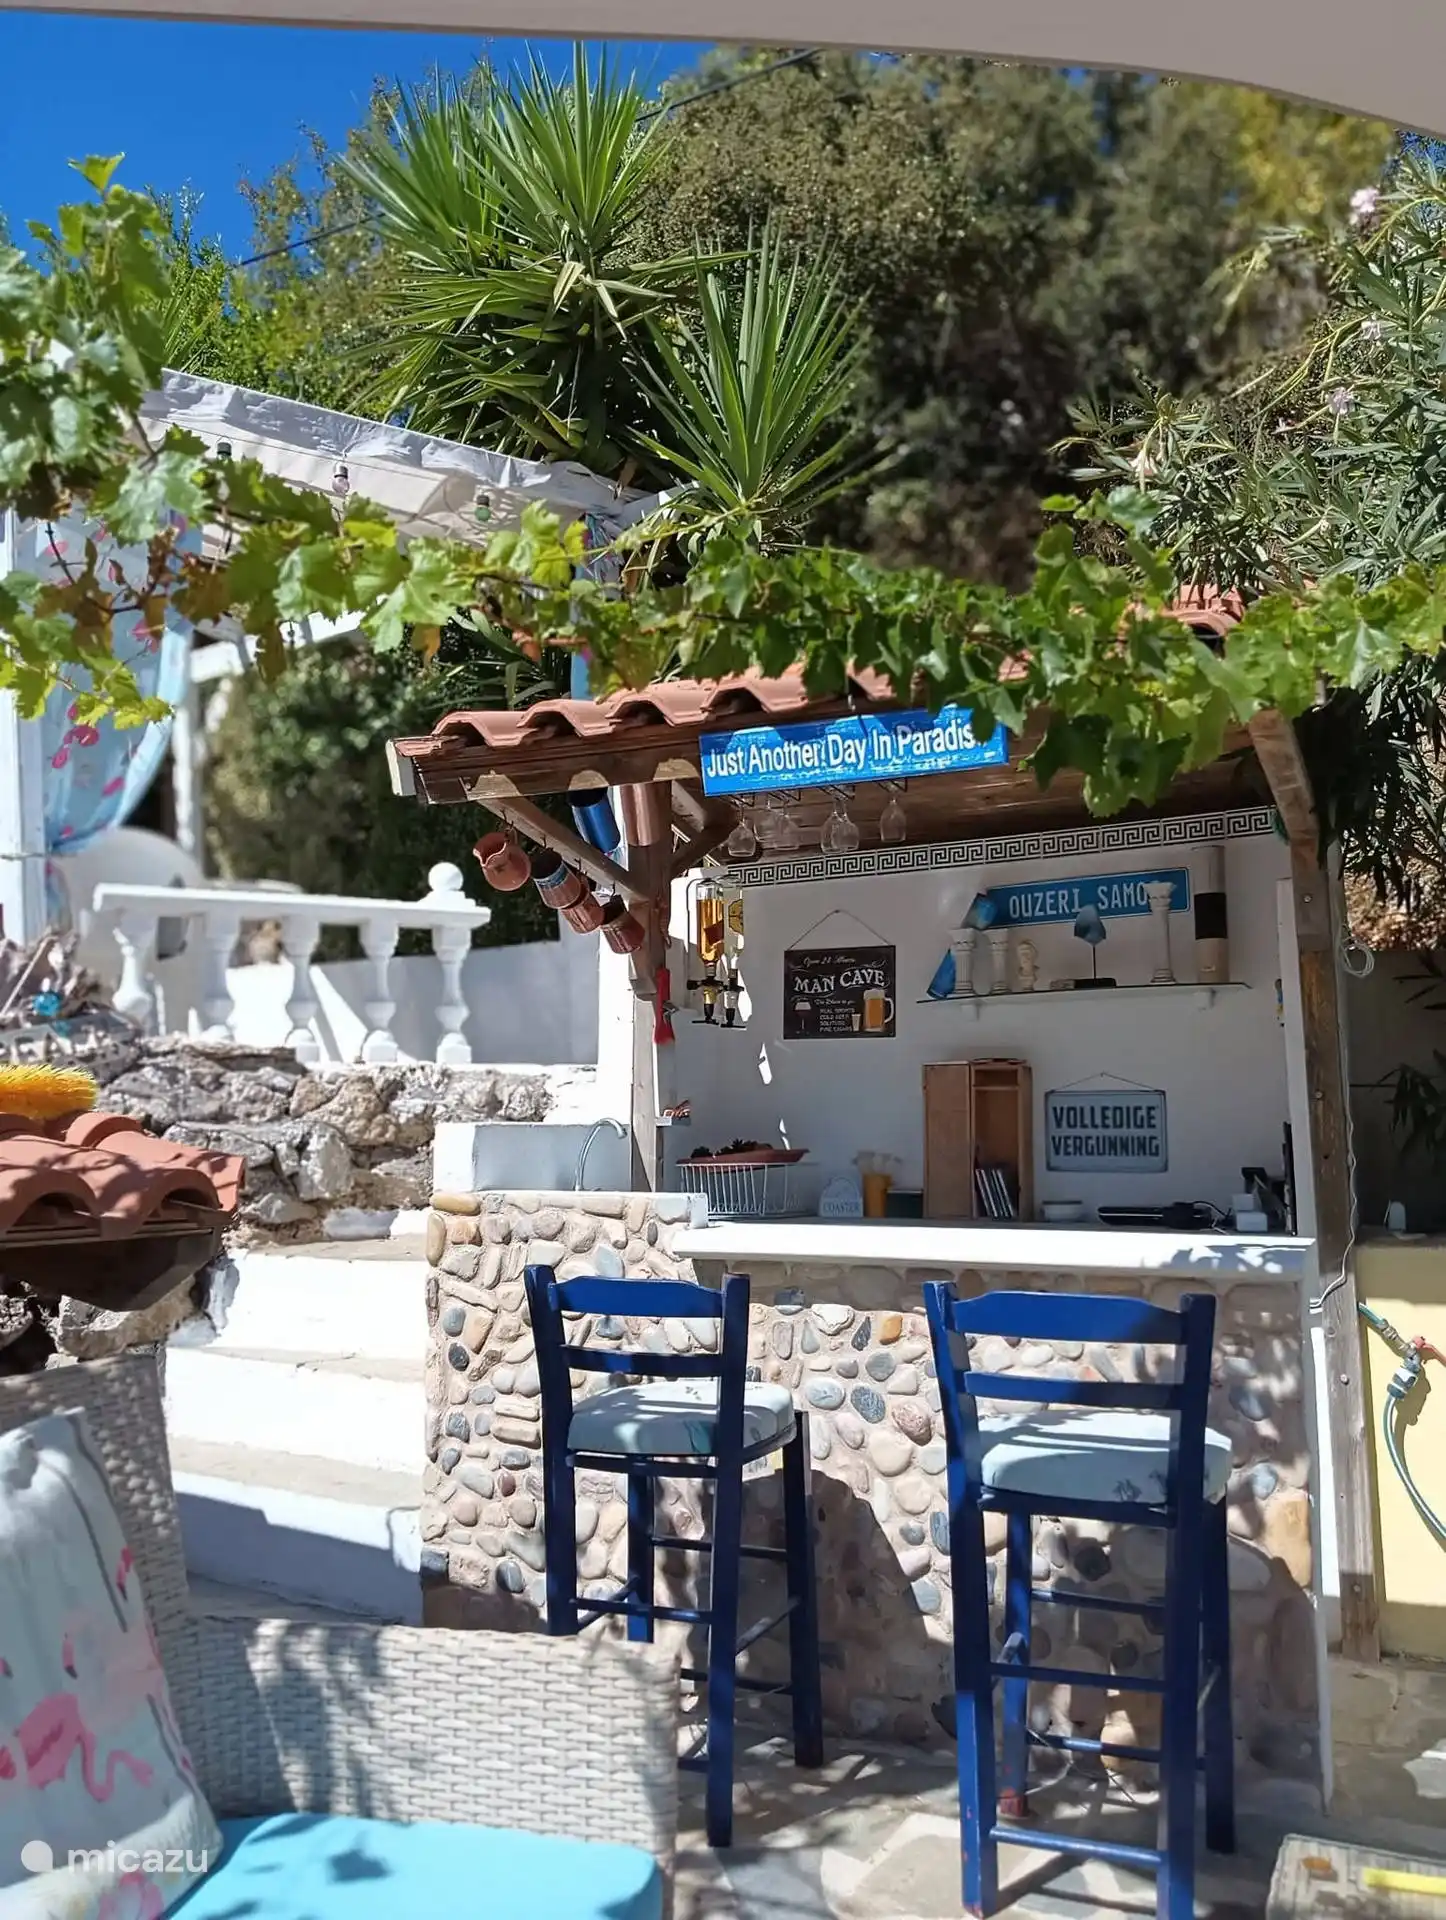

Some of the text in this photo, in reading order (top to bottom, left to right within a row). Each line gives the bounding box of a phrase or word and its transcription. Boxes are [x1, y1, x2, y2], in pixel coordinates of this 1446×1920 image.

[707, 718, 988, 778] Just Another Day In Paradis
[1008, 880, 1161, 919] OUZERI SAMO
[794, 969, 885, 994] MAN CAVE
[1051, 1105, 1157, 1129] VOLLEDIGE
[1051, 1135, 1160, 1157] VERGUNNING
